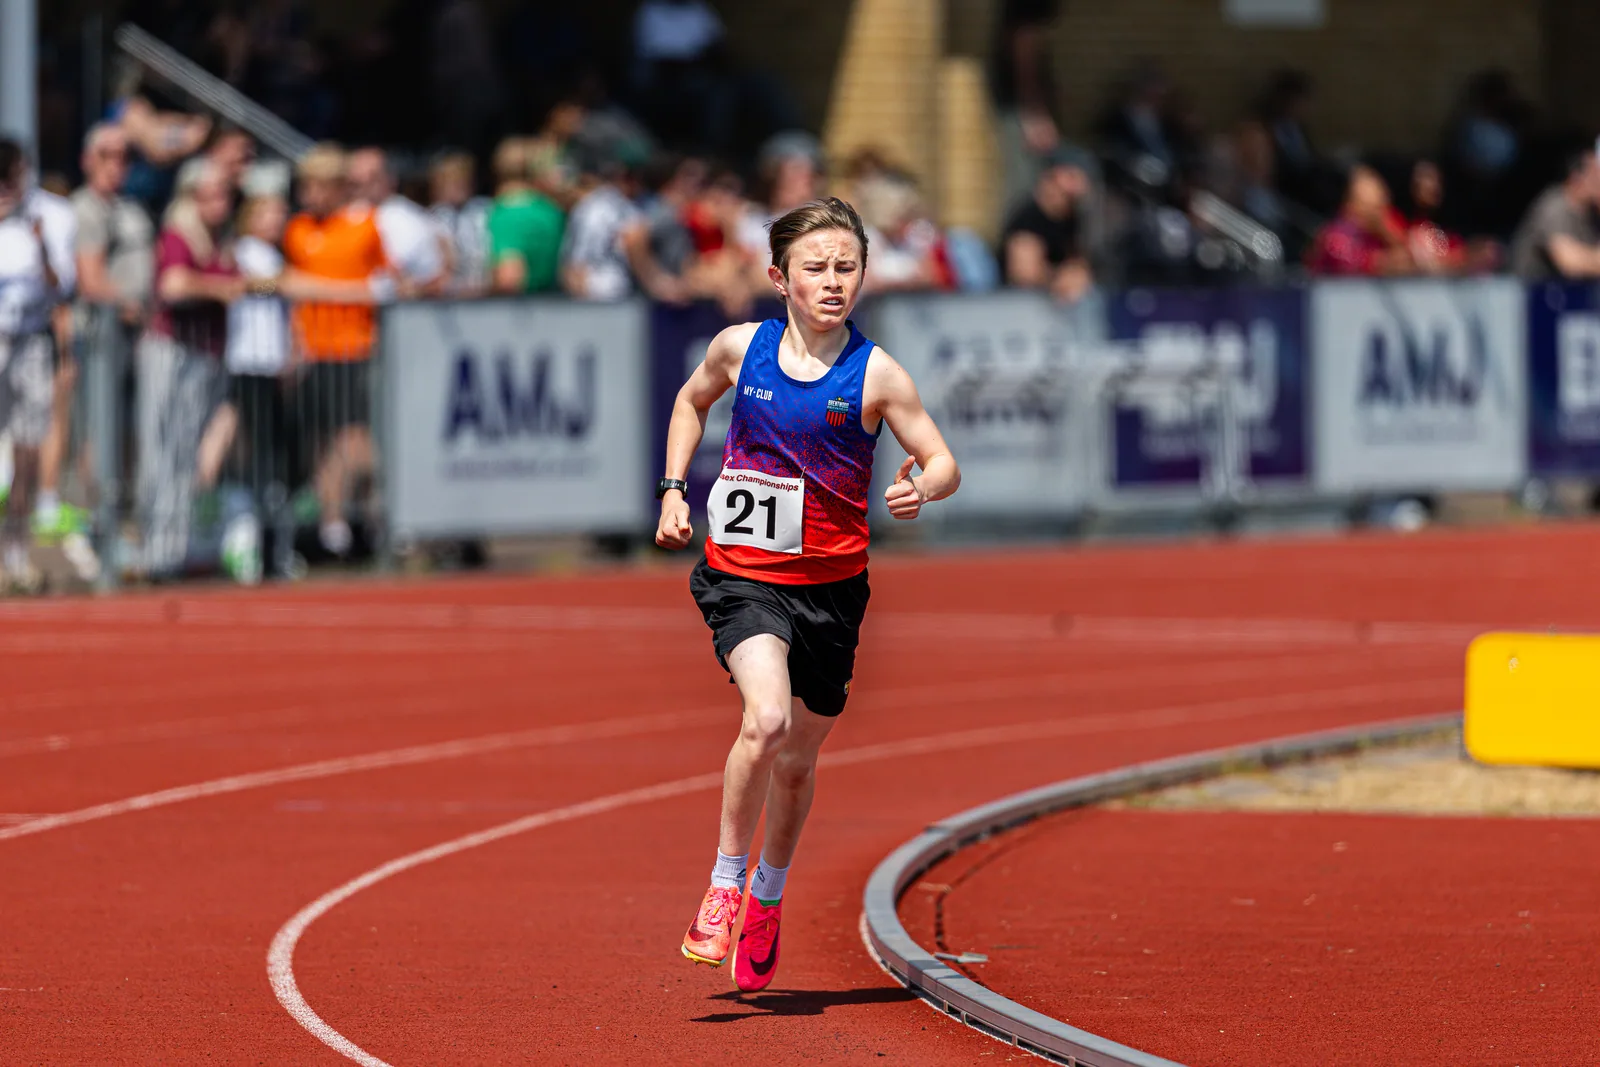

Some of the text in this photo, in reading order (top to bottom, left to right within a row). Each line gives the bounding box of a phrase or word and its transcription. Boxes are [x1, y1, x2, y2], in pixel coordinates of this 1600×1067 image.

[443, 345, 598, 443] AMJ
[736, 474, 799, 492] Championships
[724, 489, 776, 540] 21
